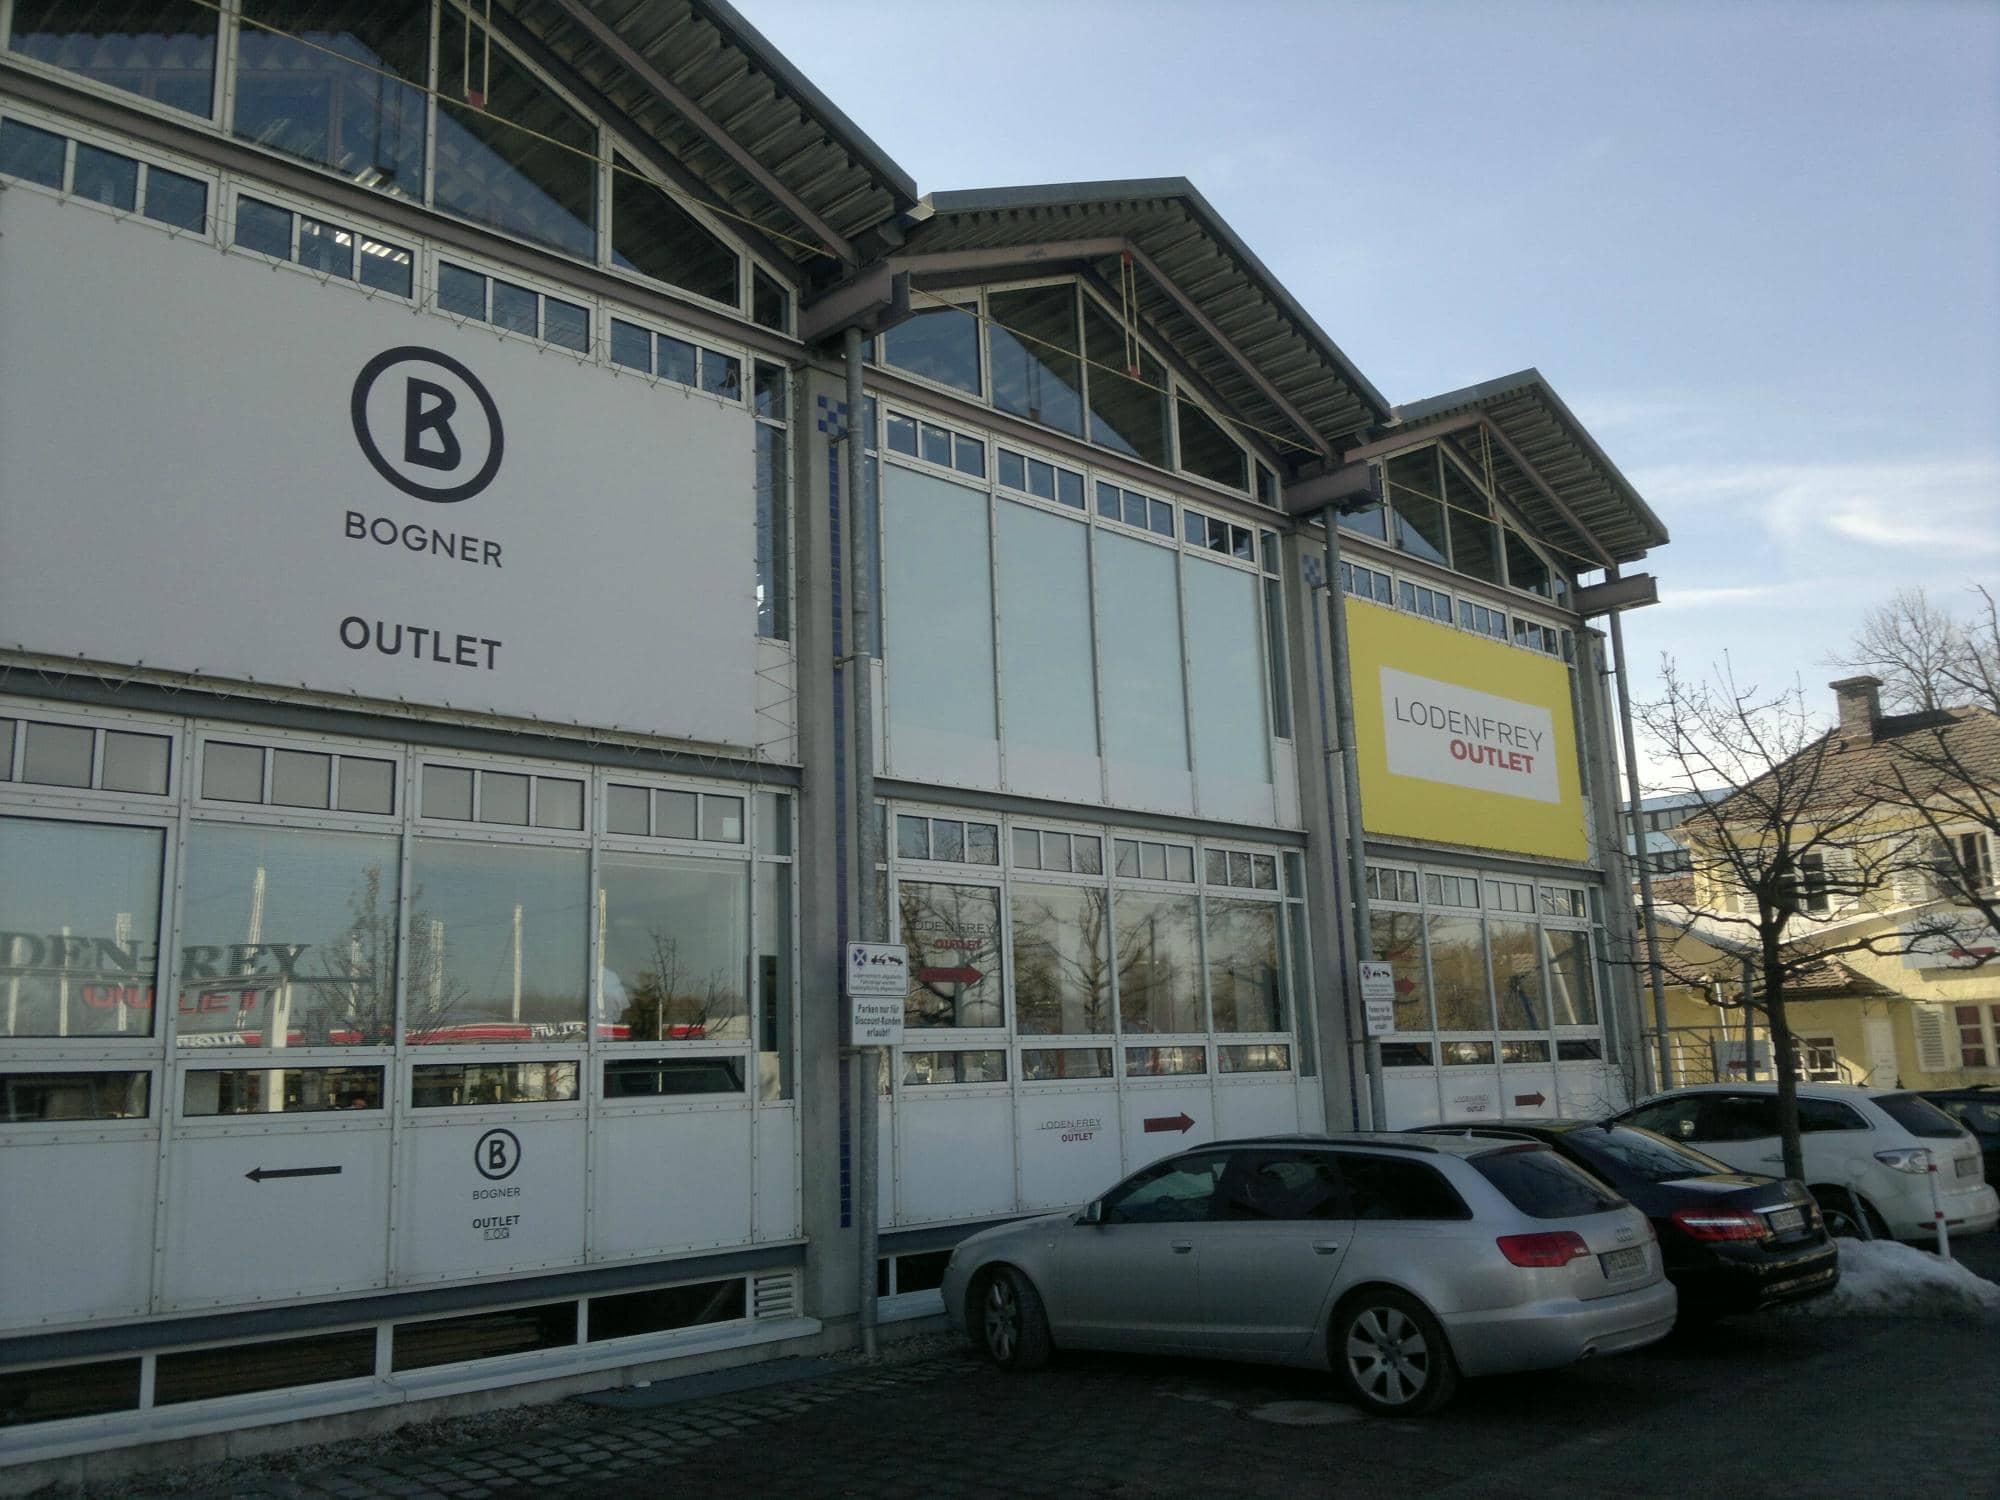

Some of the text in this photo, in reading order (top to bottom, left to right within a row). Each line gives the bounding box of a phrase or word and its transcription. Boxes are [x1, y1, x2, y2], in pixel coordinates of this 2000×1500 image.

[404, 376, 462, 472] B
[344, 511, 503, 568] BOGNER
[340, 616, 502, 671] OUTLET
[1395, 697, 1543, 752] LODENFREY
[1450, 739, 1534, 774] OUTLET
[1061, 1132, 1094, 1142] OUTLET
[472, 1187, 521, 1200] BOGNER
[472, 1215, 521, 1229] OUTLET
